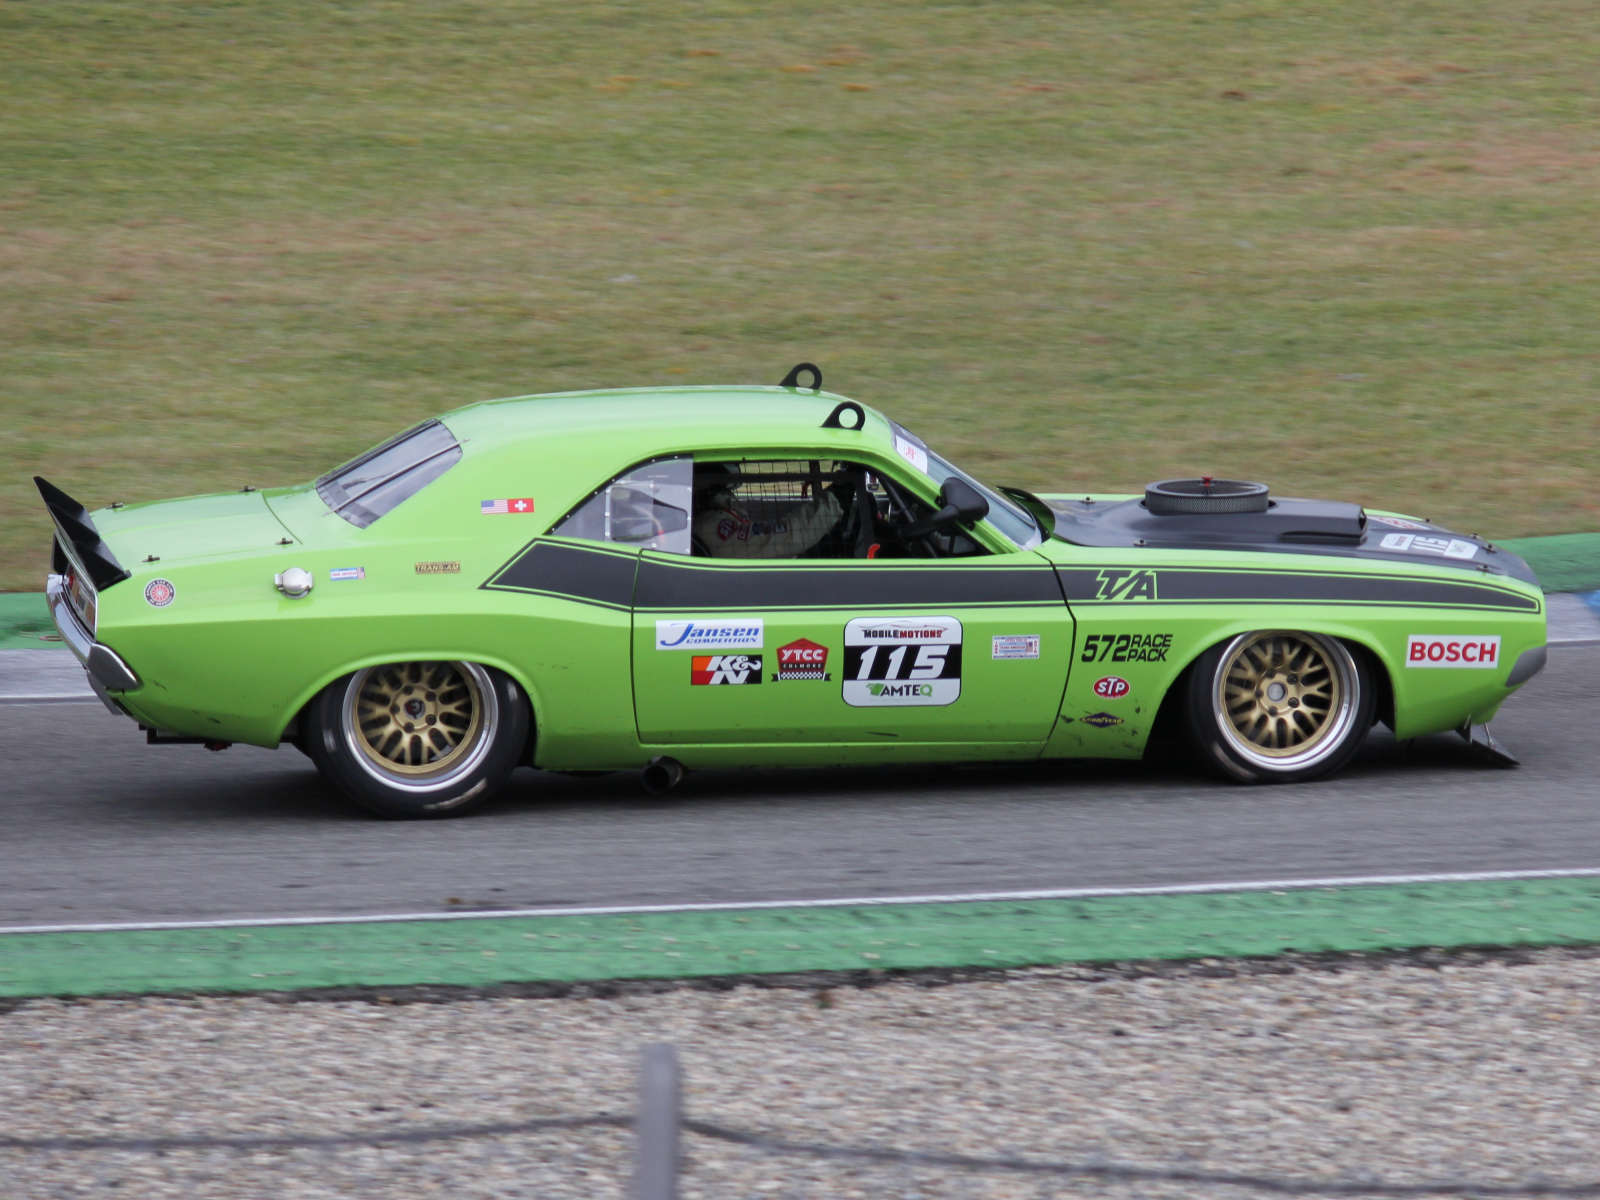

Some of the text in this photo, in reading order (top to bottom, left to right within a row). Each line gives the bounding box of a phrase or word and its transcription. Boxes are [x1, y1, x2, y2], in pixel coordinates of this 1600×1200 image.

[660, 623, 759, 646] Jansen
[1131, 634, 1173, 648] RACE
[781, 649, 823, 661] YTCC
[1081, 634, 1131, 662] 572
[1127, 648, 1170, 662] PACK
[1409, 642, 1497, 662] BOSCH
[856, 645, 950, 680] 115
[1097, 677, 1126, 695] STP
